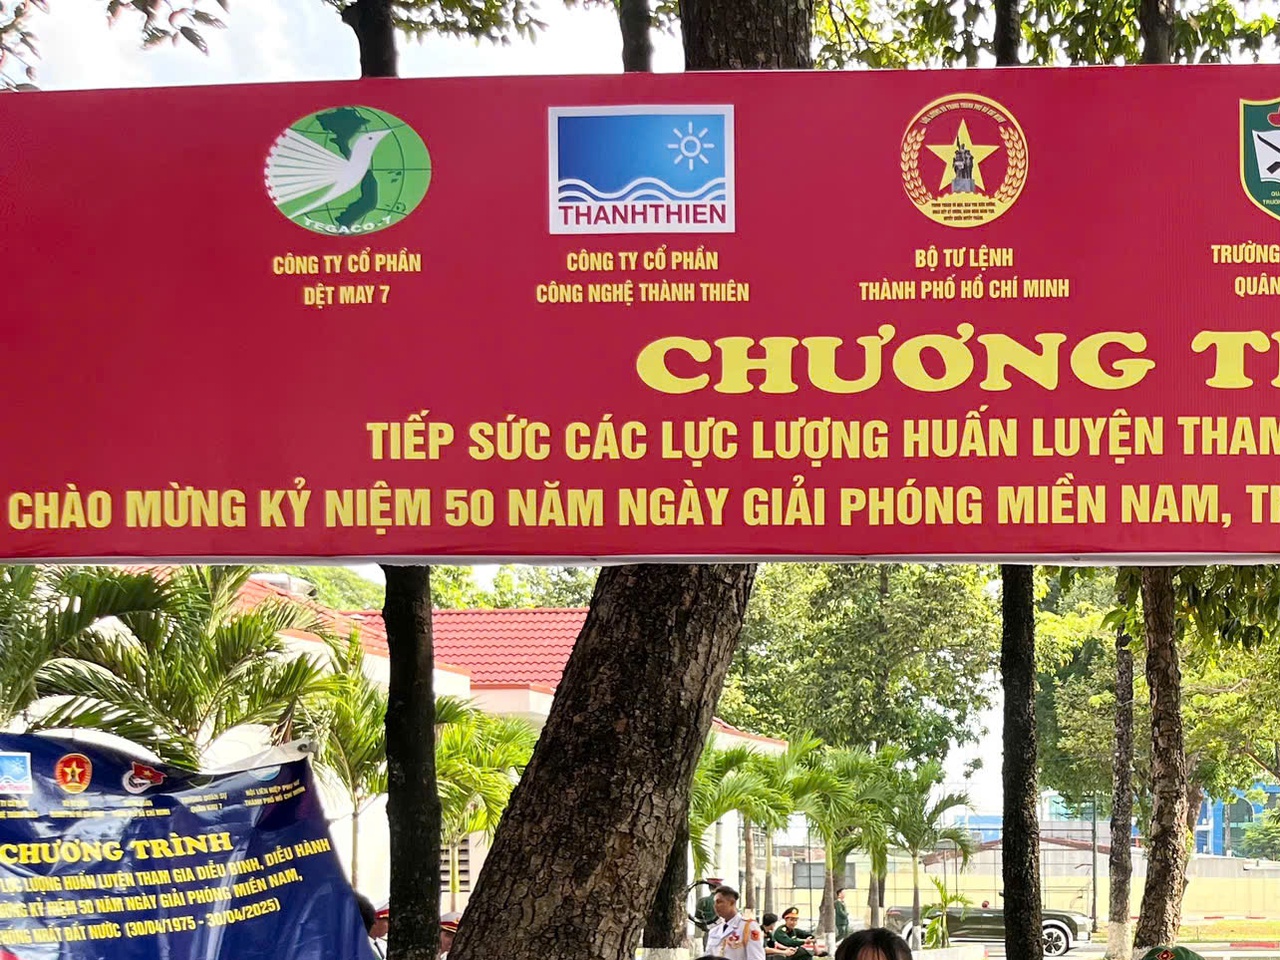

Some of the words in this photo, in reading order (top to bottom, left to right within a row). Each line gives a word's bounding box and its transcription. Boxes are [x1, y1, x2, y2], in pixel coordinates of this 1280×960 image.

[558, 204, 726, 225] THANHTHIEN
[273, 252, 319, 275] CÔNG
[323, 254, 343, 274] TY
[347, 246, 371, 273] CỔ
[374, 247, 421, 272] PHẦN
[566, 248, 614, 272] CÔNG
[618, 251, 639, 271] TY
[643, 244, 667, 271] CỔ
[671, 245, 719, 270] PHẦN
[915, 245, 939, 272] BỘ
[942, 246, 967, 268] TƯ
[969, 244, 1014, 271] LỆNH
[1210, 240, 1280, 264] TRƯỜNG
[304, 282, 335, 309] DỆT
[339, 285, 375, 304] MAY
[379, 285, 390, 304] 7
[536, 280, 583, 303] CÔNG
[588, 279, 634, 306] NGHỆ
[638, 279, 695, 302] THÀNH
[699, 279, 750, 302] THIÊN
[858, 277, 916, 301] THÀNH
[920, 273, 956, 300] PHỐ
[960, 273, 984, 299] HỒ
[989, 275, 1018, 299] CHÍ
[1023, 278, 1070, 298] MINH
[635, 322, 1156, 394] CHƯƠNG
[366, 409, 454, 460] TIẾP
[468, 414, 551, 461] SỨC
[565, 413, 647, 461] CÁC
[661, 417, 738, 468] LỰC
[752, 416, 889, 467] LƯỢNG
[903, 404, 1018, 458] HUẤN
[1032, 408, 1164, 464] LUYỆN
[8, 483, 112, 530] CHÀO
[125, 481, 246, 528] MỪNG
[260, 476, 312, 528] KỶ
[325, 480, 431, 535] NIỆM
[445, 488, 494, 527] 50
[508, 480, 604, 527] NĂM
[618, 479, 730, 526] NGÀY
[743, 474, 825, 526] GIẢI
[840, 478, 983, 526] PHÓNG
[997, 472, 1106, 524] MIỀN
[1121, 484, 1232, 528] NAM,
[0, 839, 124, 864] CHƯƠNG
[130, 832, 233, 860] TRÌNH
[136, 869, 171, 887] THAM
[173, 867, 195, 883] GIA
[228, 857, 264, 876] BINH,
[293, 838, 331, 858] HÀNH
[160, 888, 186, 908] GIẢI
[187, 886, 232, 906] PHÓNG
[268, 867, 303, 889] NAM,
[125, 915, 196, 938] (30/04/1975
[207, 897, 281, 927] 30/04/2025)
